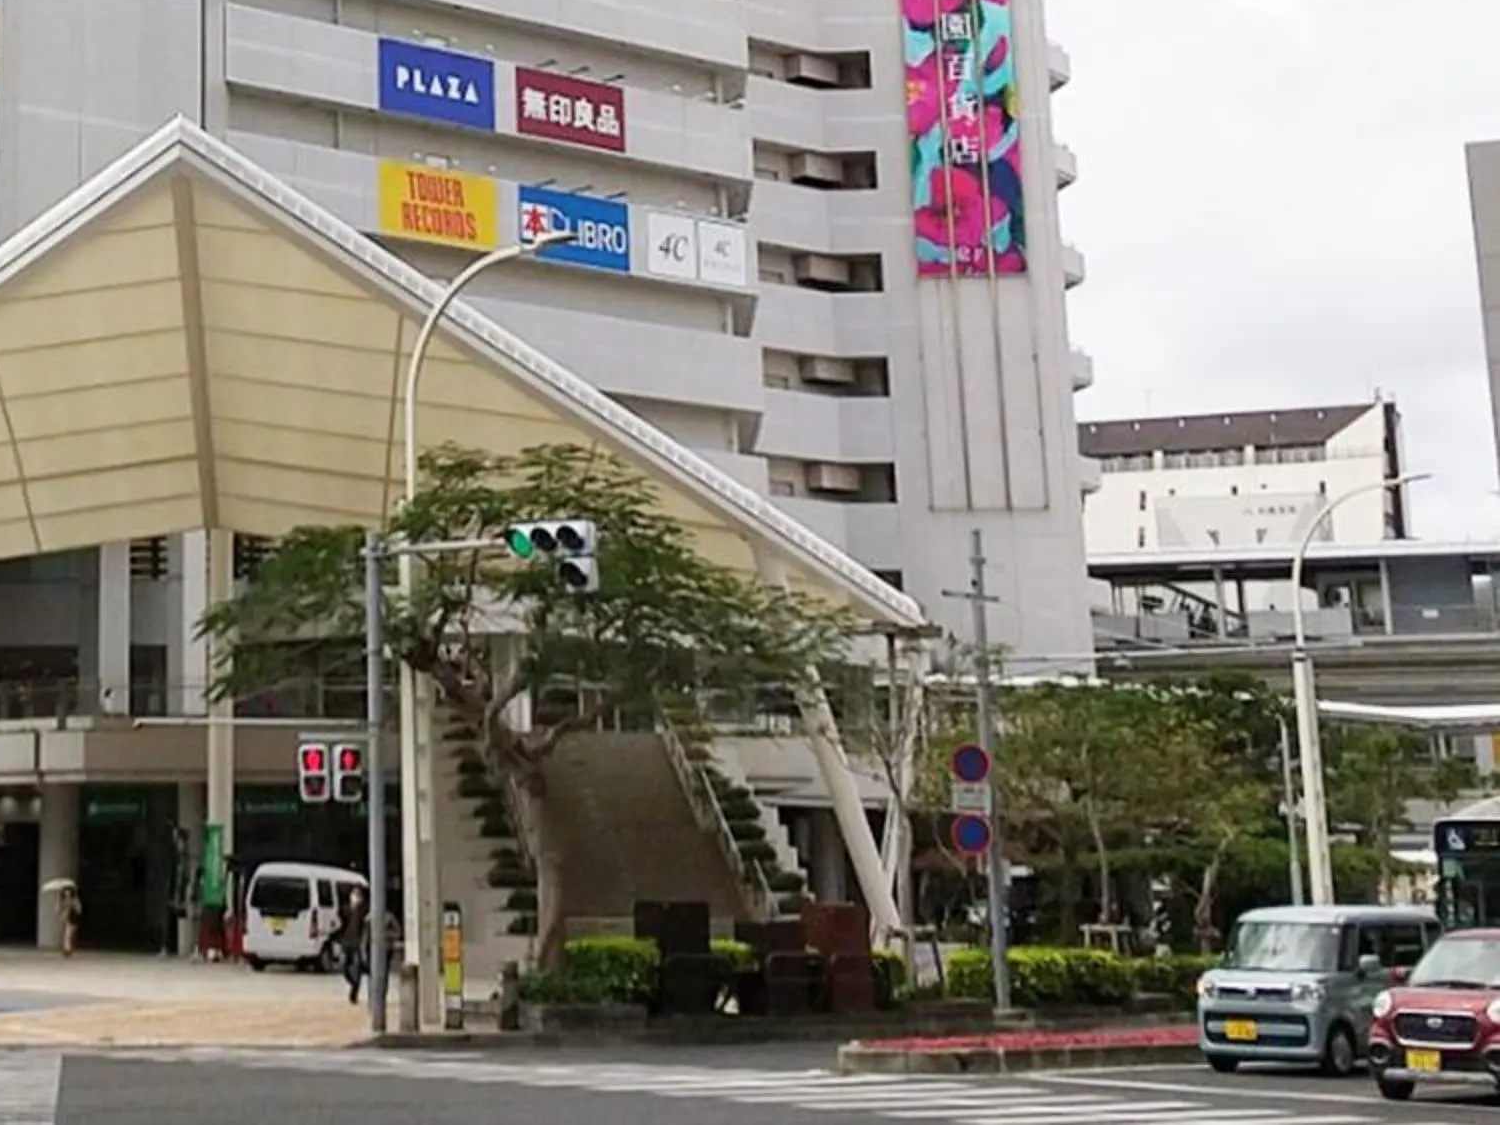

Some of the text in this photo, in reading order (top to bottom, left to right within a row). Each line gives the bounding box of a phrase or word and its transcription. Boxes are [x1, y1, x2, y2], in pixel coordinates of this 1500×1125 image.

[396, 65, 479, 105] PLAZA
[521, 86, 620, 136] 無印良品
[405, 171, 465, 208] TOWER
[401, 201, 477, 241] RECORDS
[659, 232, 689, 263] 4C
